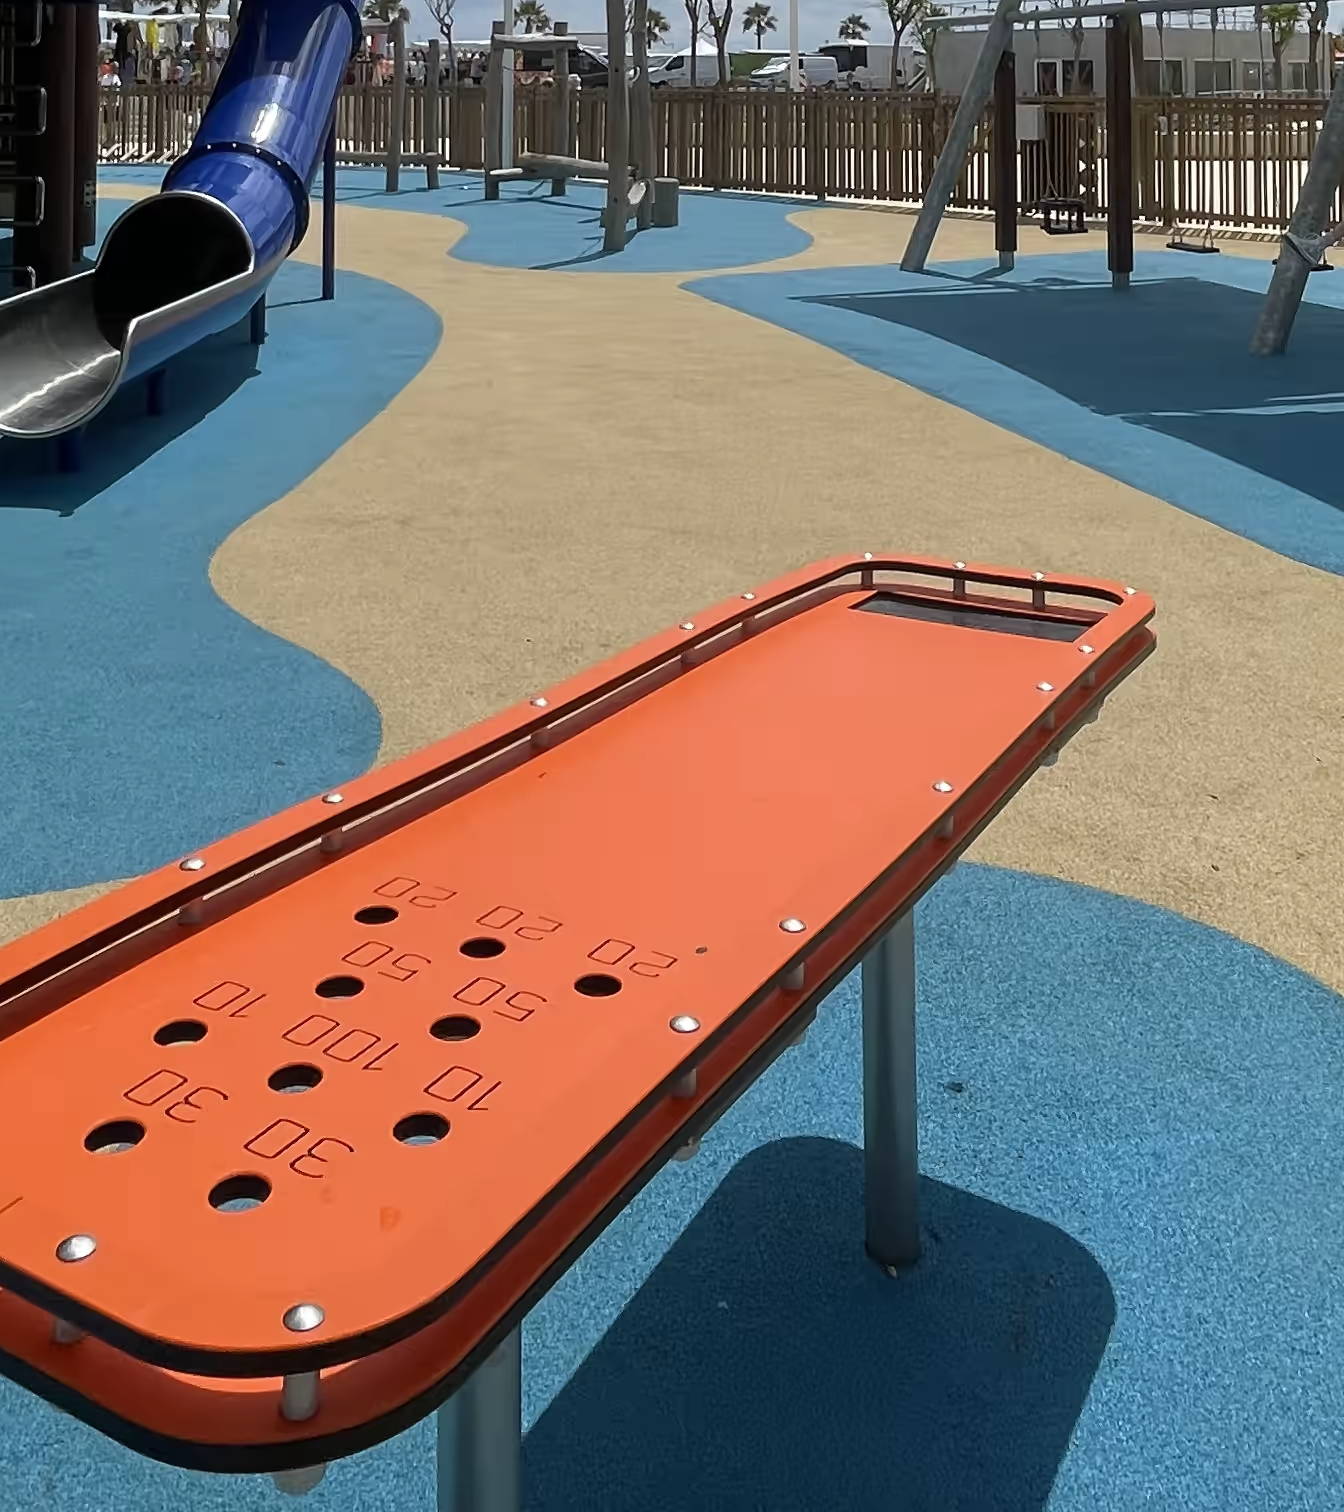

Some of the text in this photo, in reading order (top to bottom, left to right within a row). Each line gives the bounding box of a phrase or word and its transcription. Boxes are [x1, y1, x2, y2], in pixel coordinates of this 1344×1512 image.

[373, 876, 457, 909] 20
[476, 905, 563, 941] 20
[341, 940, 432, 982] 50
[587, 938, 678, 978] 20
[192, 980, 267, 1018] 10
[452, 976, 548, 1023] 50
[282, 1014, 400, 1071] 100
[122, 1068, 230, 1124] 30
[422, 1065, 505, 1111] 10
[243, 1118, 355, 1179] 30
